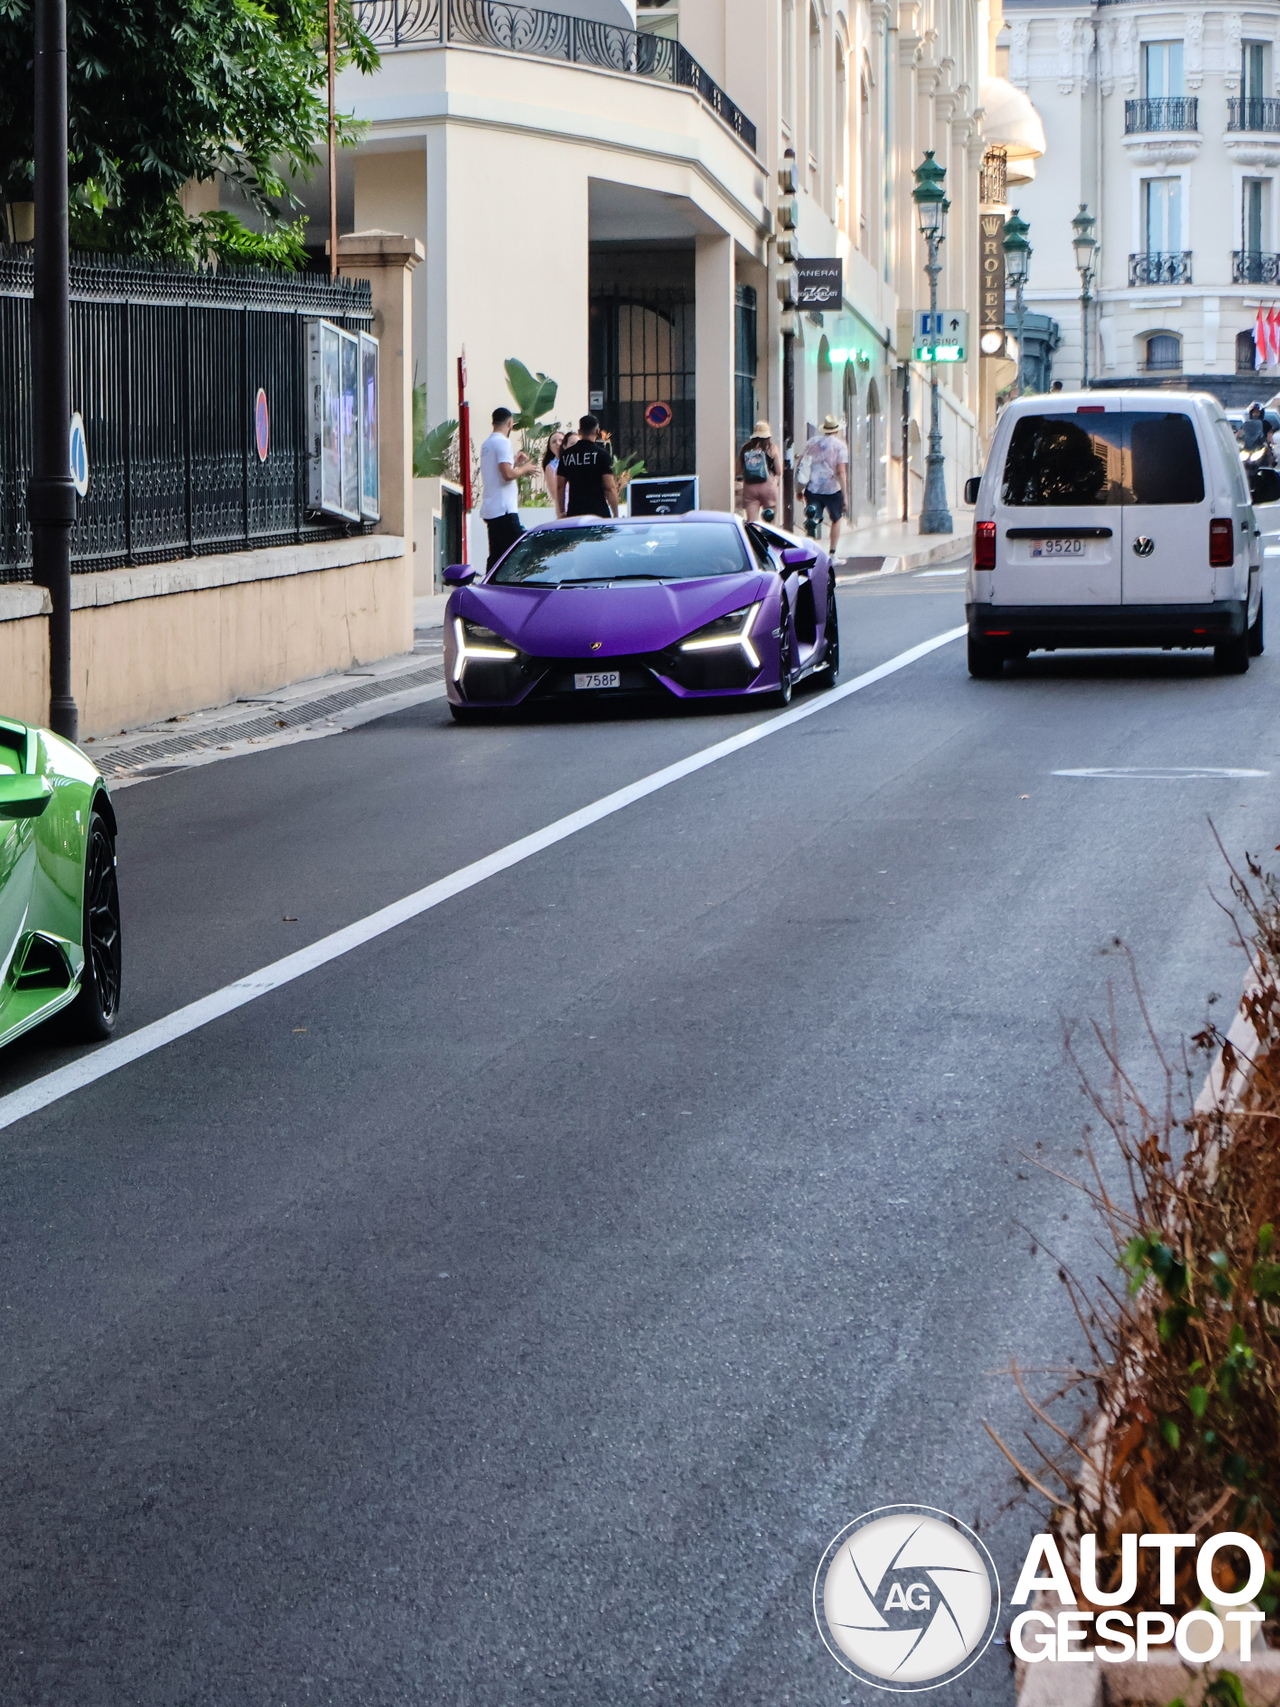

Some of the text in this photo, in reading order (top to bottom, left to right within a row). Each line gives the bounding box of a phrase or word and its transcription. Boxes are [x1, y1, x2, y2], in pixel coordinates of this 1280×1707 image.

[984, 242, 999, 322] ROLEX
[922, 338, 958, 346] CSINO
[562, 452, 598, 467] VALET
[1045, 540, 1081, 553] 952D
[586, 673, 617, 687] 758P
